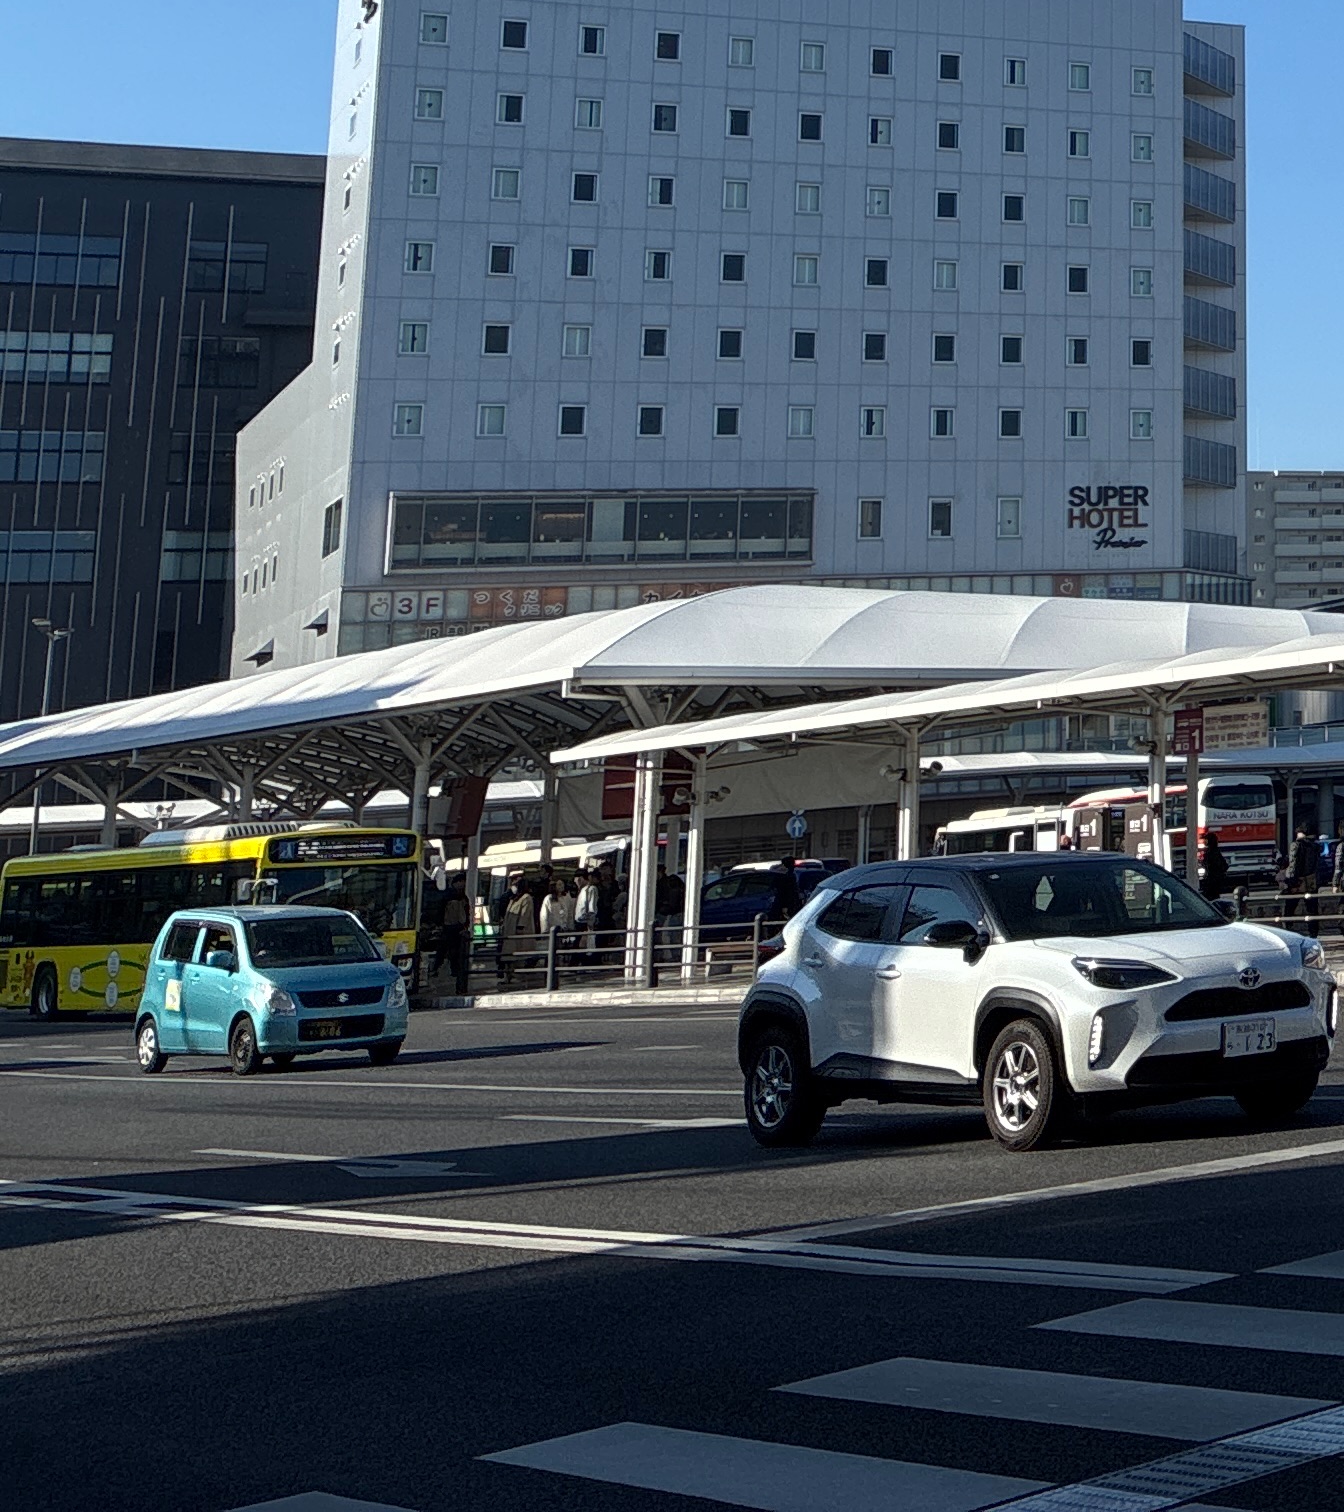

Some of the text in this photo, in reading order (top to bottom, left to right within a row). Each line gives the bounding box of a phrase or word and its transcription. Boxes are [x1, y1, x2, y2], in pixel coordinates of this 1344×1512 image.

[1068, 485, 1149, 507] SUPER
[1067, 507, 1148, 529] HOTEL
[1191, 728, 1200, 750] 1
[1213, 810, 1269, 820] NARA KOTSU
